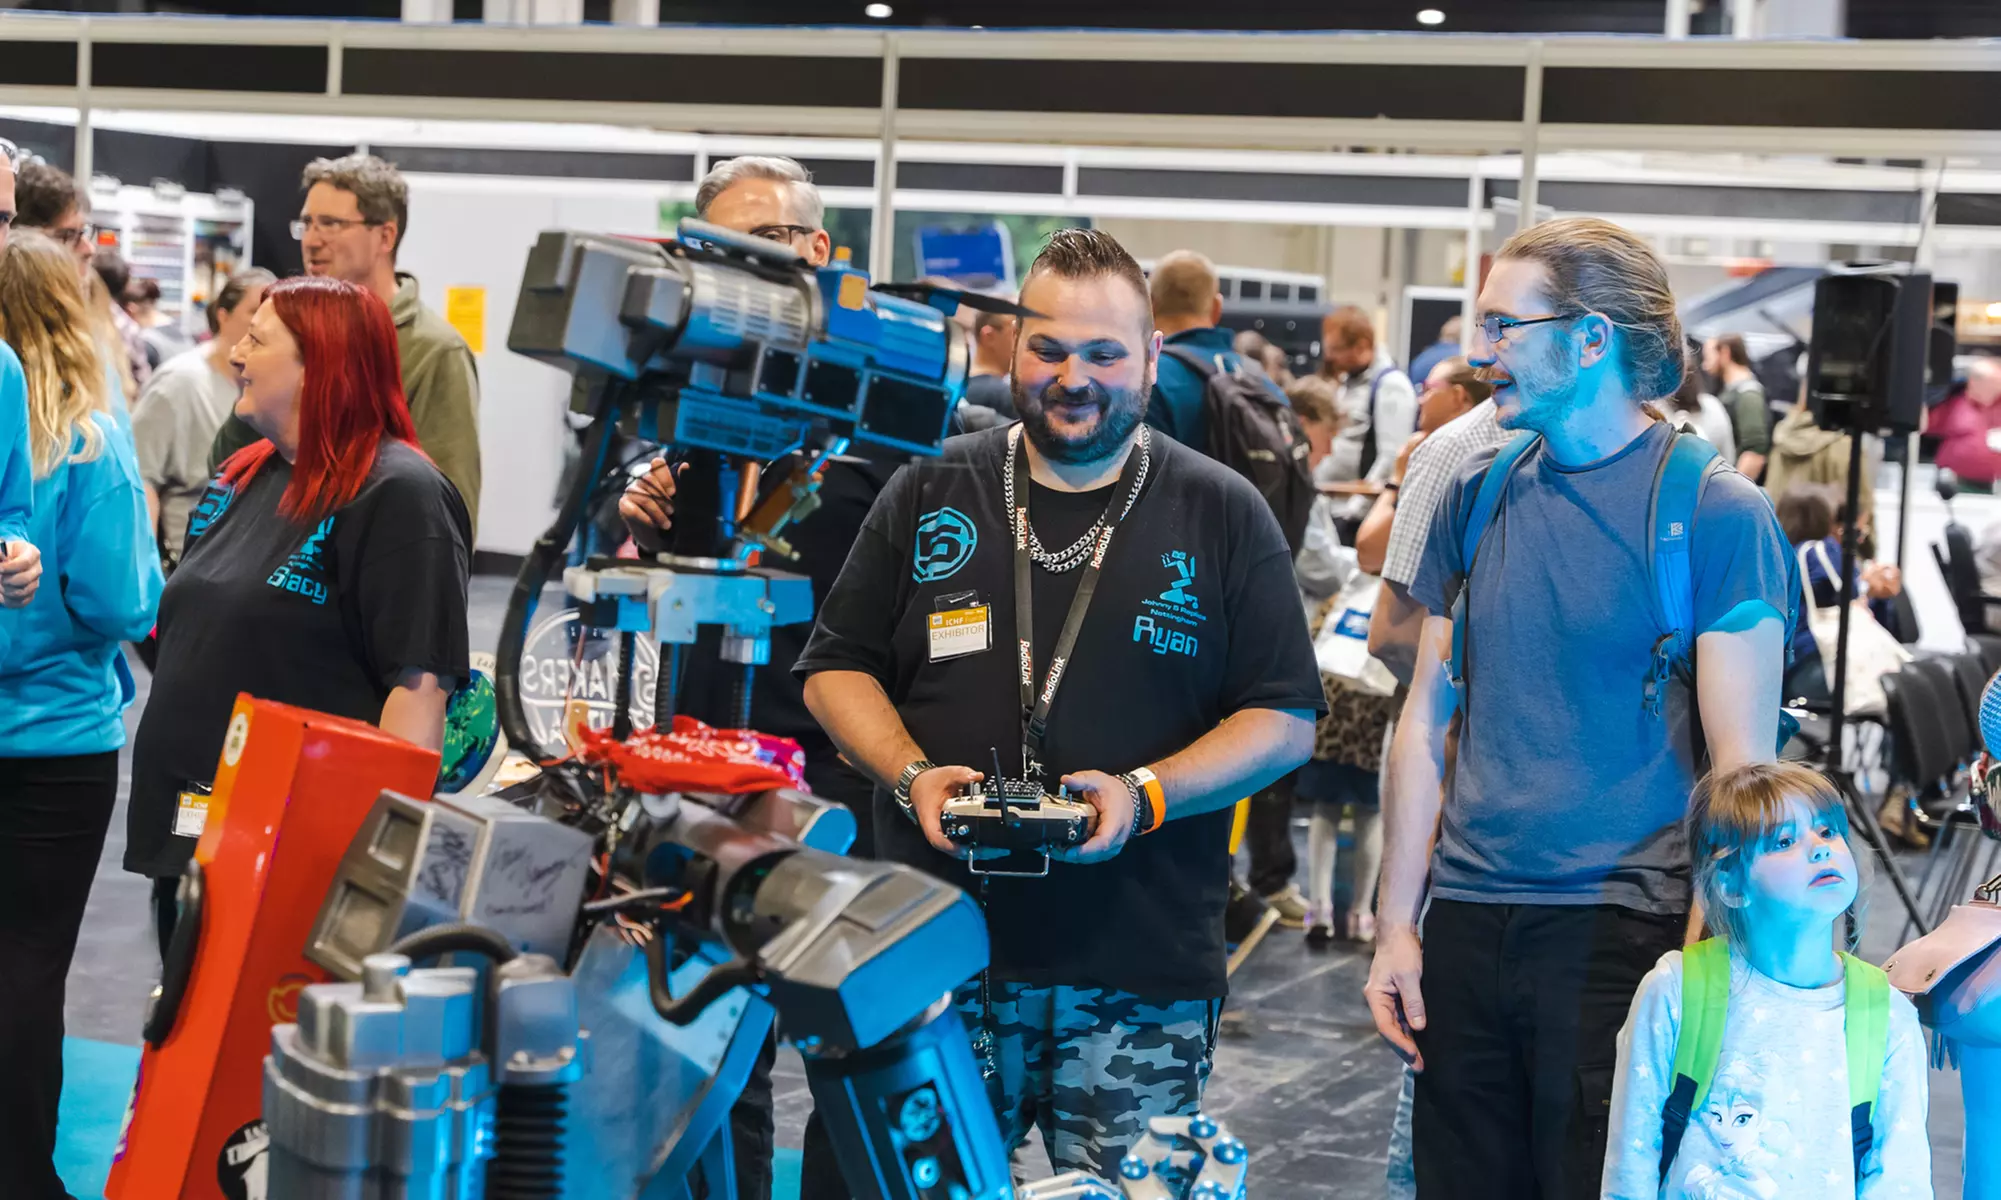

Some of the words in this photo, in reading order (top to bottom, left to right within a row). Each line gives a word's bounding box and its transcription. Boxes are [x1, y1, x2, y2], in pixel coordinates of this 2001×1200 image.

[1016, 506, 1028, 551] RadioLink
[1090, 525, 1115, 570] RadioLink
[266, 566, 328, 605] Sacy
[1141, 599, 1172, 611] Johnny
[932, 625, 985, 641] EXHIBITOR
[945, 617, 964, 626] ICHF
[1133, 615, 1198, 657] Ryan
[1150, 608, 1198, 627] Nottingham
[1020, 638, 1032, 687] RadioLink
[1041, 656, 1066, 705] RadioLink
